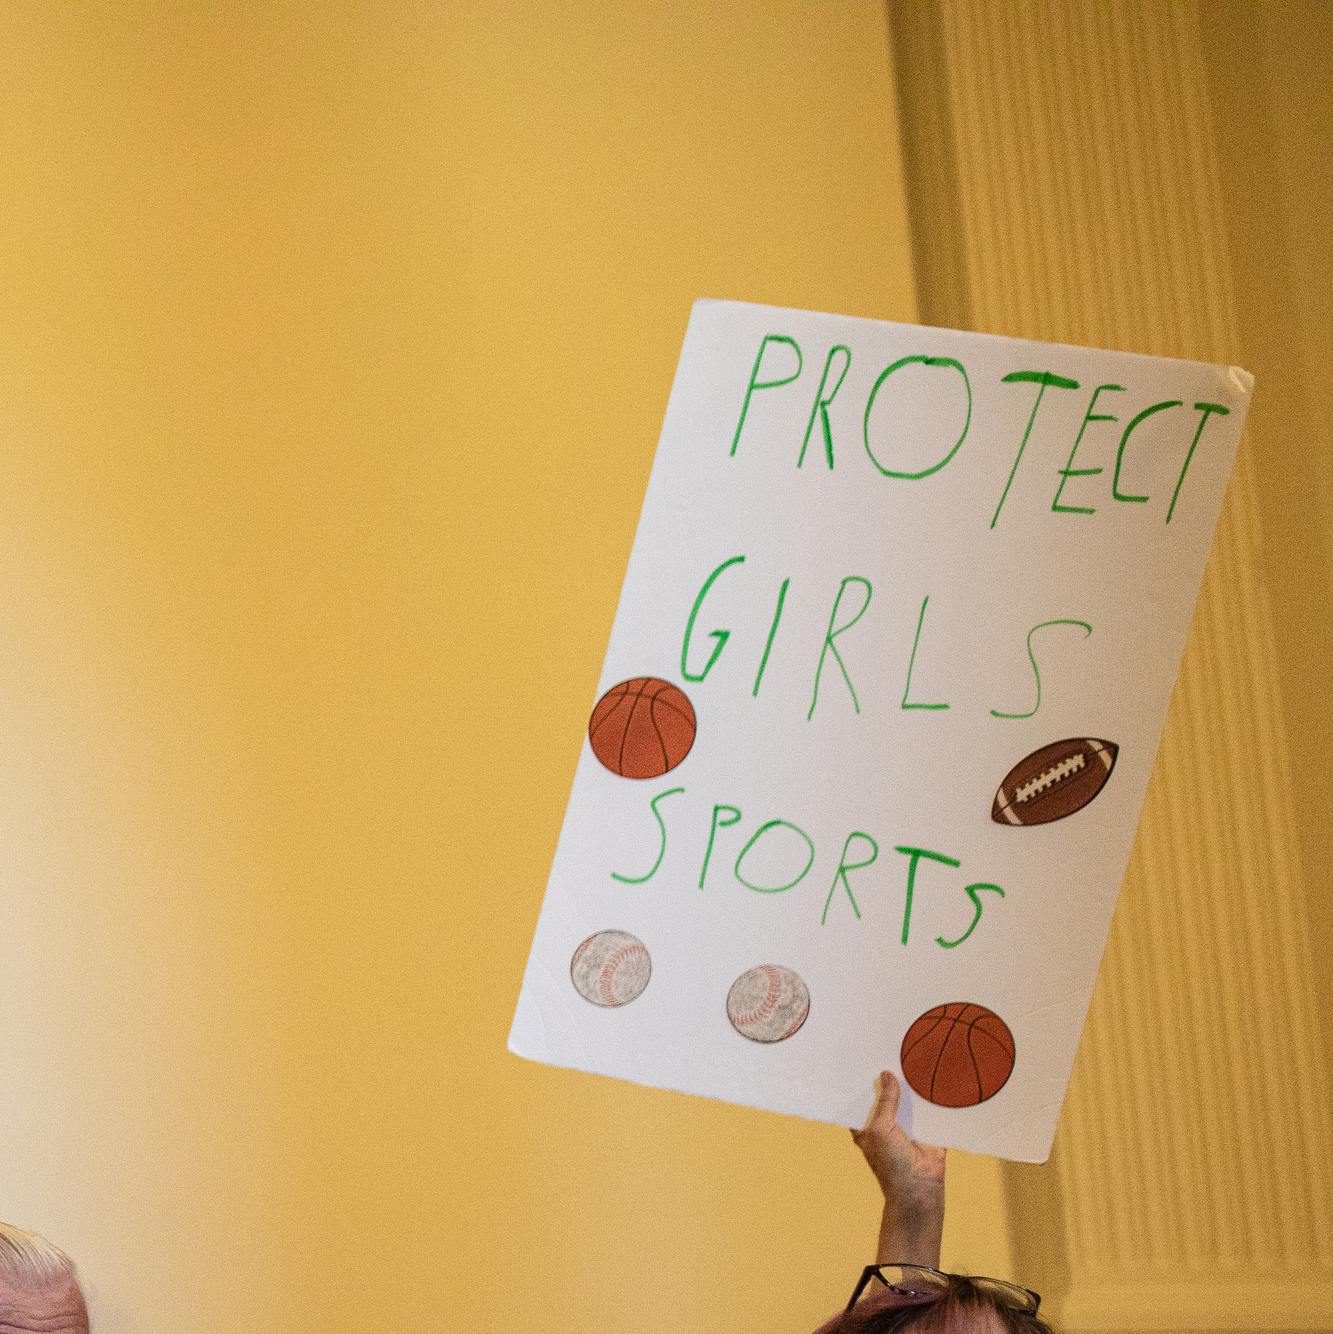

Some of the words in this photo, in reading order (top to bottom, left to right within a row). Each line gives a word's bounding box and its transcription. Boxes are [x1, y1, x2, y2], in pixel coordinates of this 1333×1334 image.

[730, 333, 1230, 529] PROTECT
[680, 554, 1093, 722] GIRLS
[610, 786, 1006, 949] SPORTS
